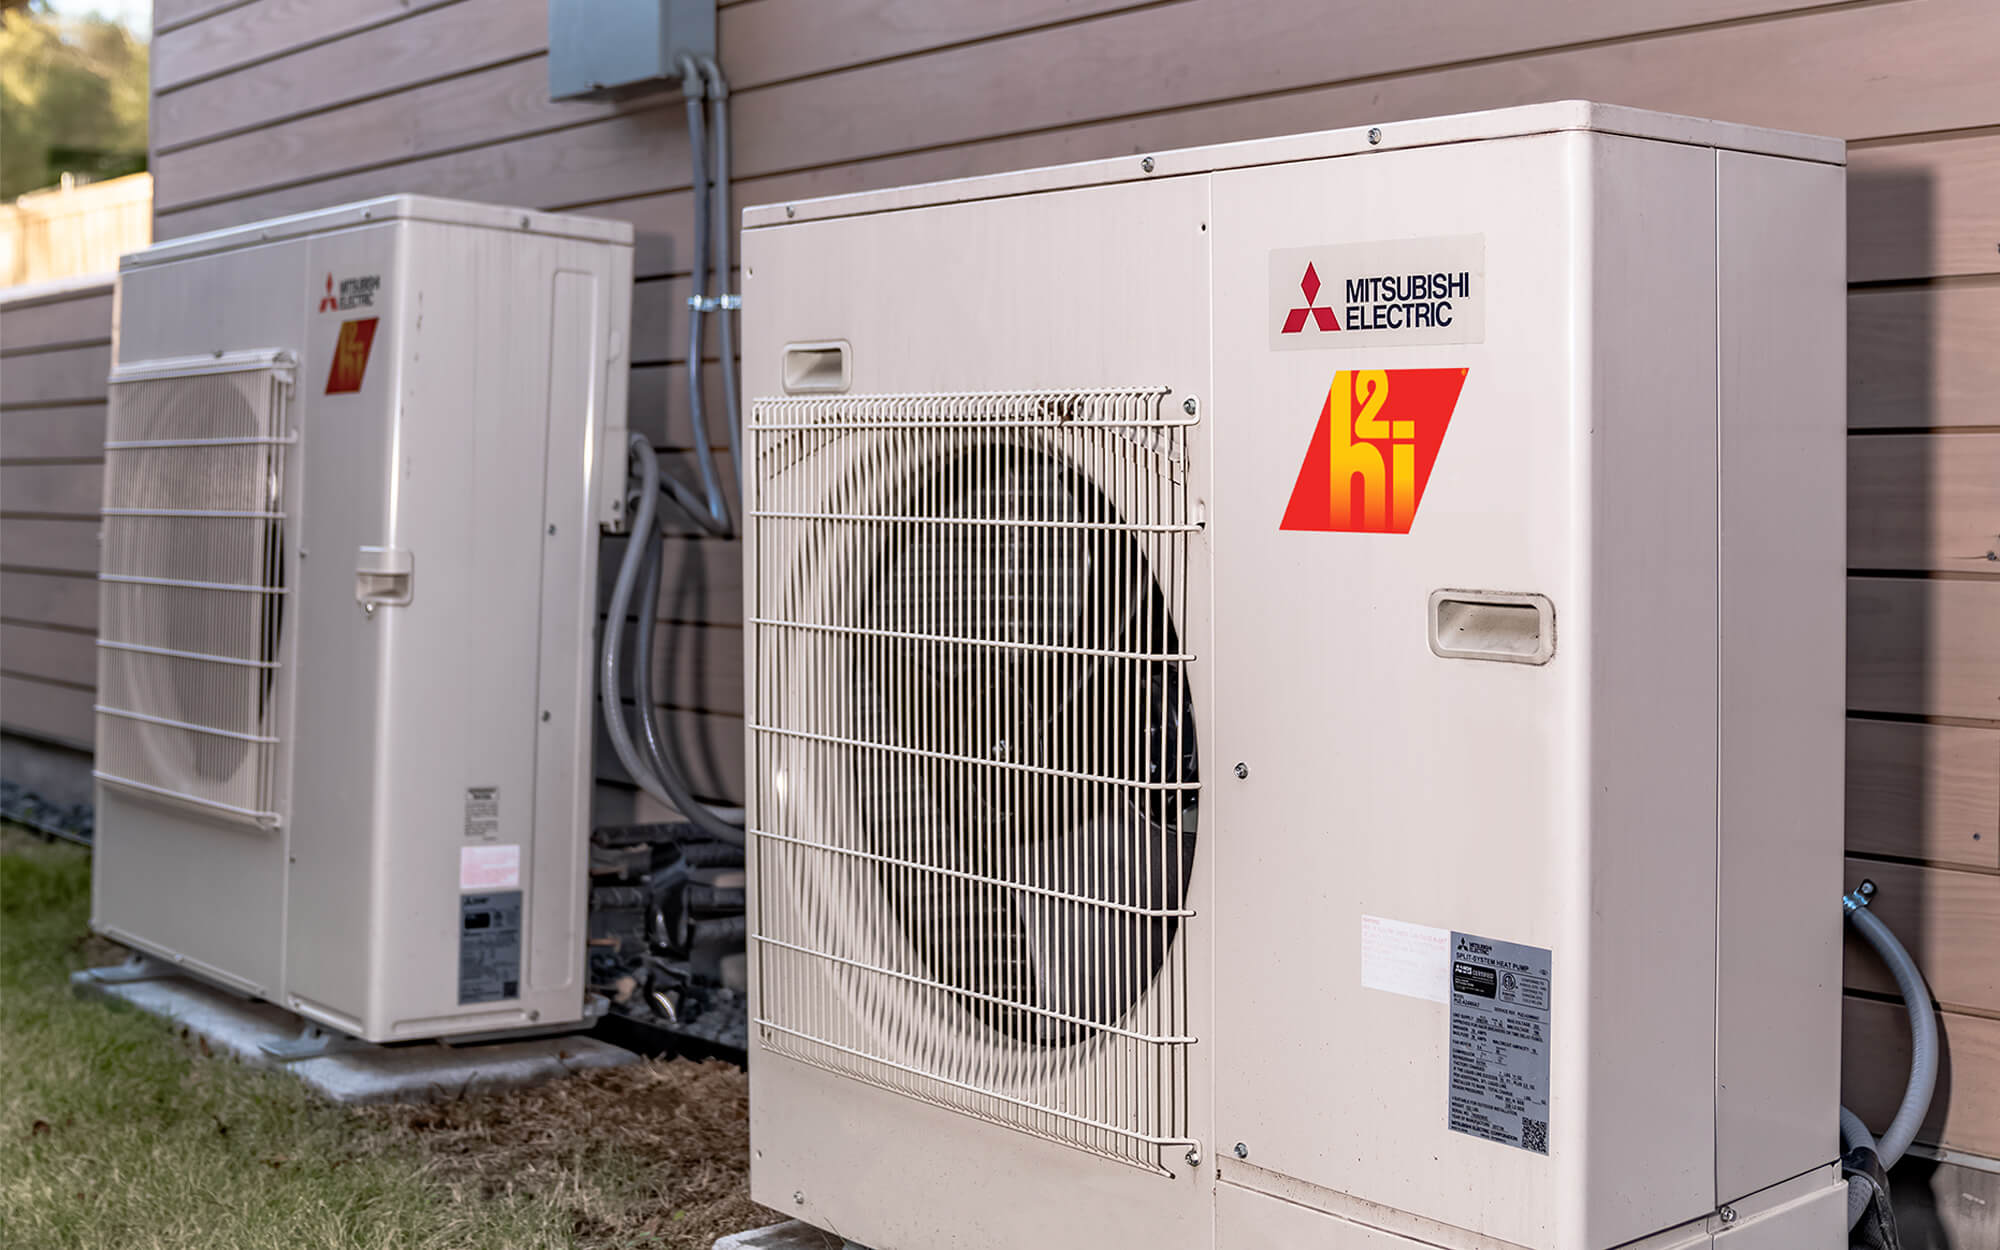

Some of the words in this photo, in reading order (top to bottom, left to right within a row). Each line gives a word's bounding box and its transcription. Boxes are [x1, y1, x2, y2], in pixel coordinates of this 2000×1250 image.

[340, 275, 380, 295] MITSUBISHI
[1346, 272, 1469, 303] MITSUBISHI
[340, 293, 374, 310] ELECTRIC
[1346, 301, 1453, 331] ELECTRIC
[1456, 951, 1495, 965] SPLIT-SYSTEM
[1496, 959, 1512, 968] HEAT
[1513, 963, 1529, 972] PUMP
